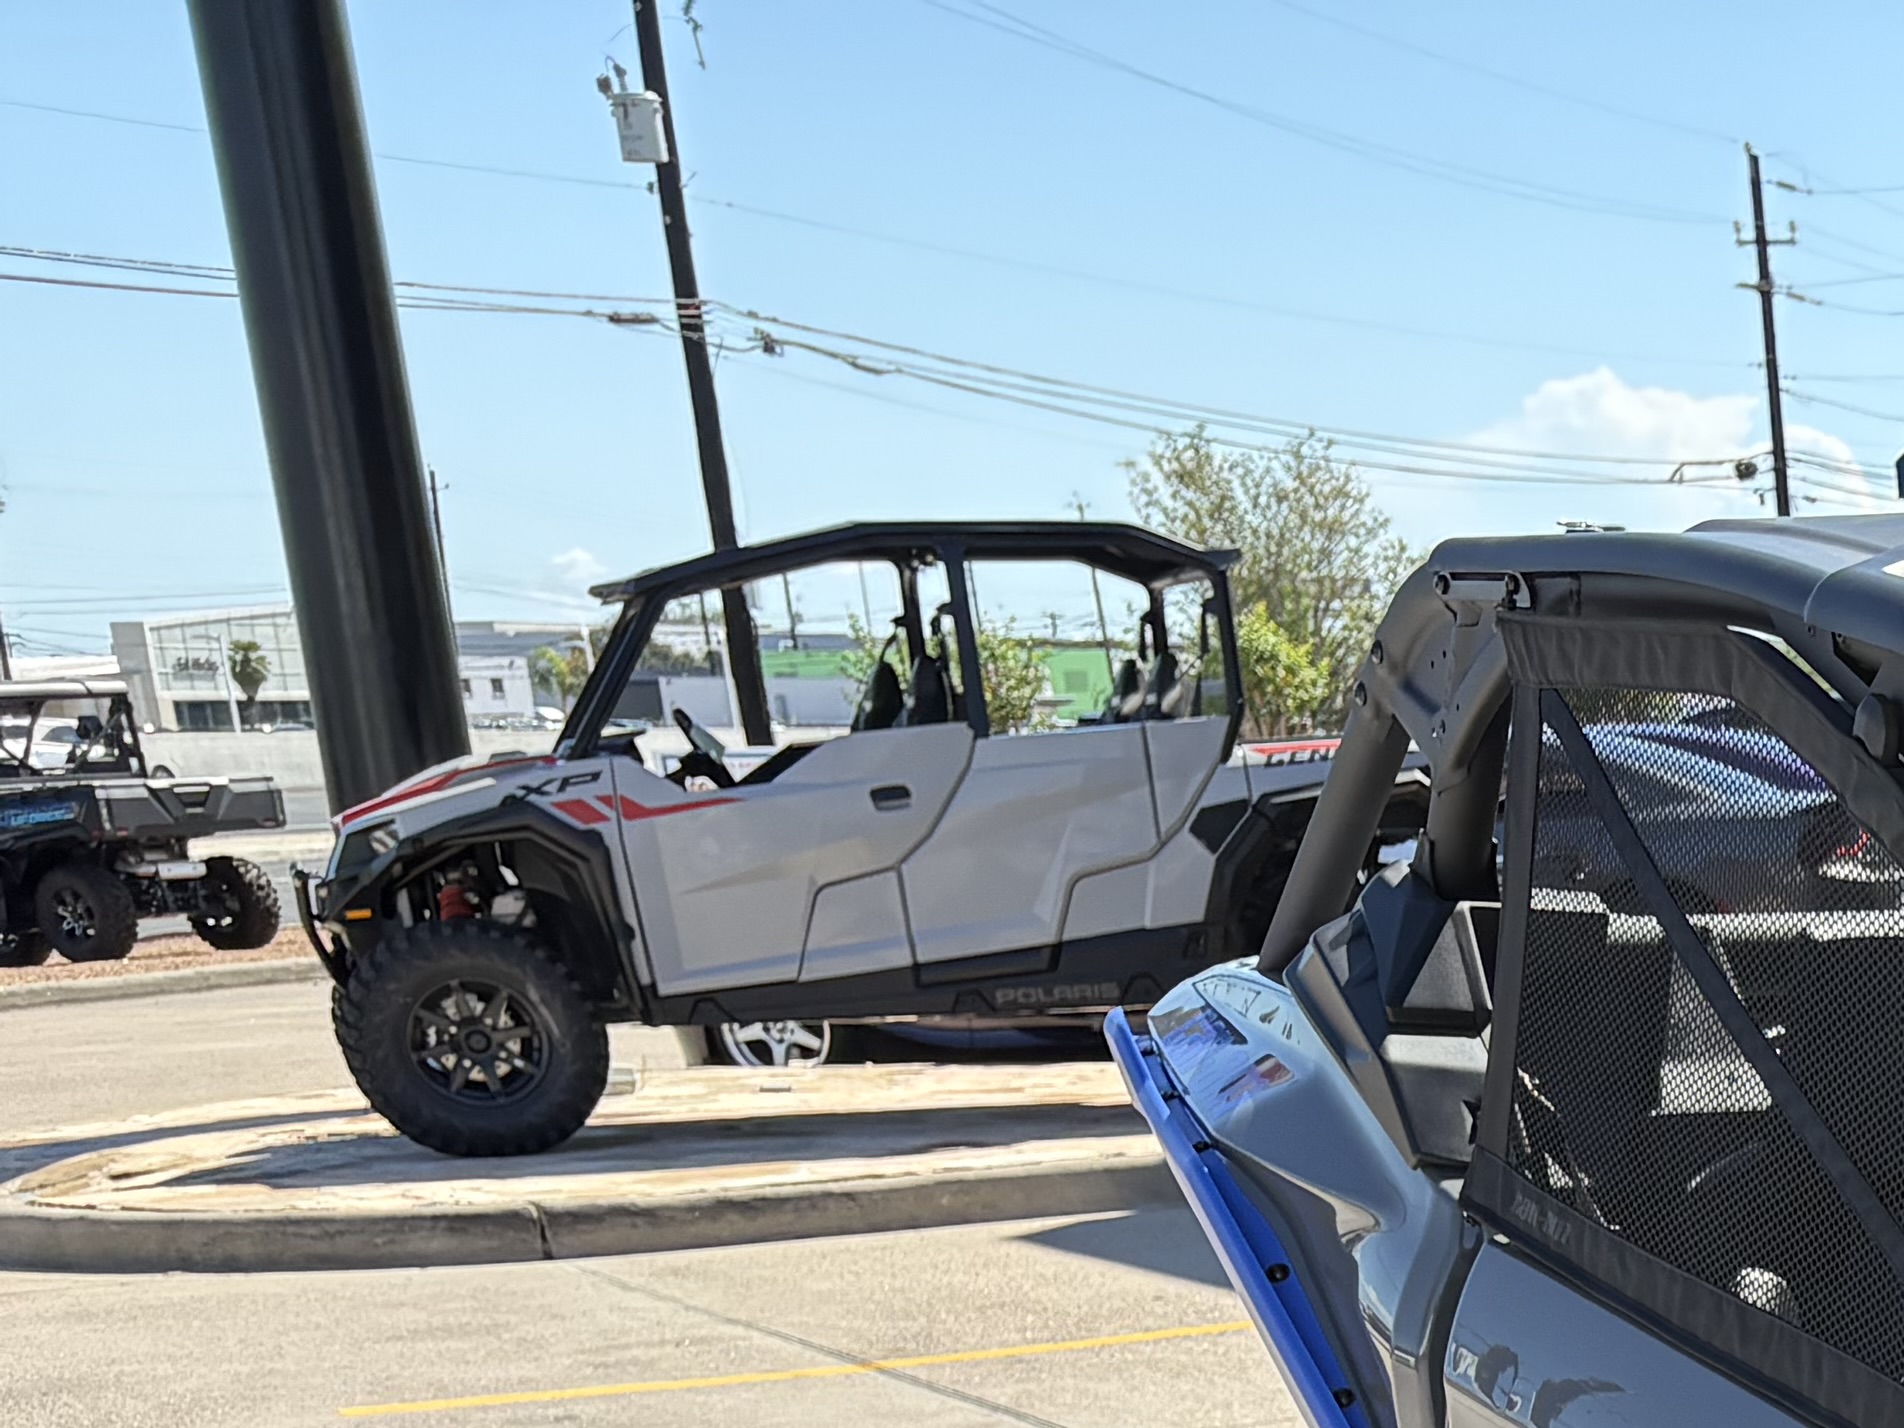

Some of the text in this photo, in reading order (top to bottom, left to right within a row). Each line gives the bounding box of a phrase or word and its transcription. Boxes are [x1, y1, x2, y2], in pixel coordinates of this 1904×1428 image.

[1264, 747, 1331, 768] GEN
[516, 769, 603, 800] XP
[994, 982, 1121, 1004] POLARIS
